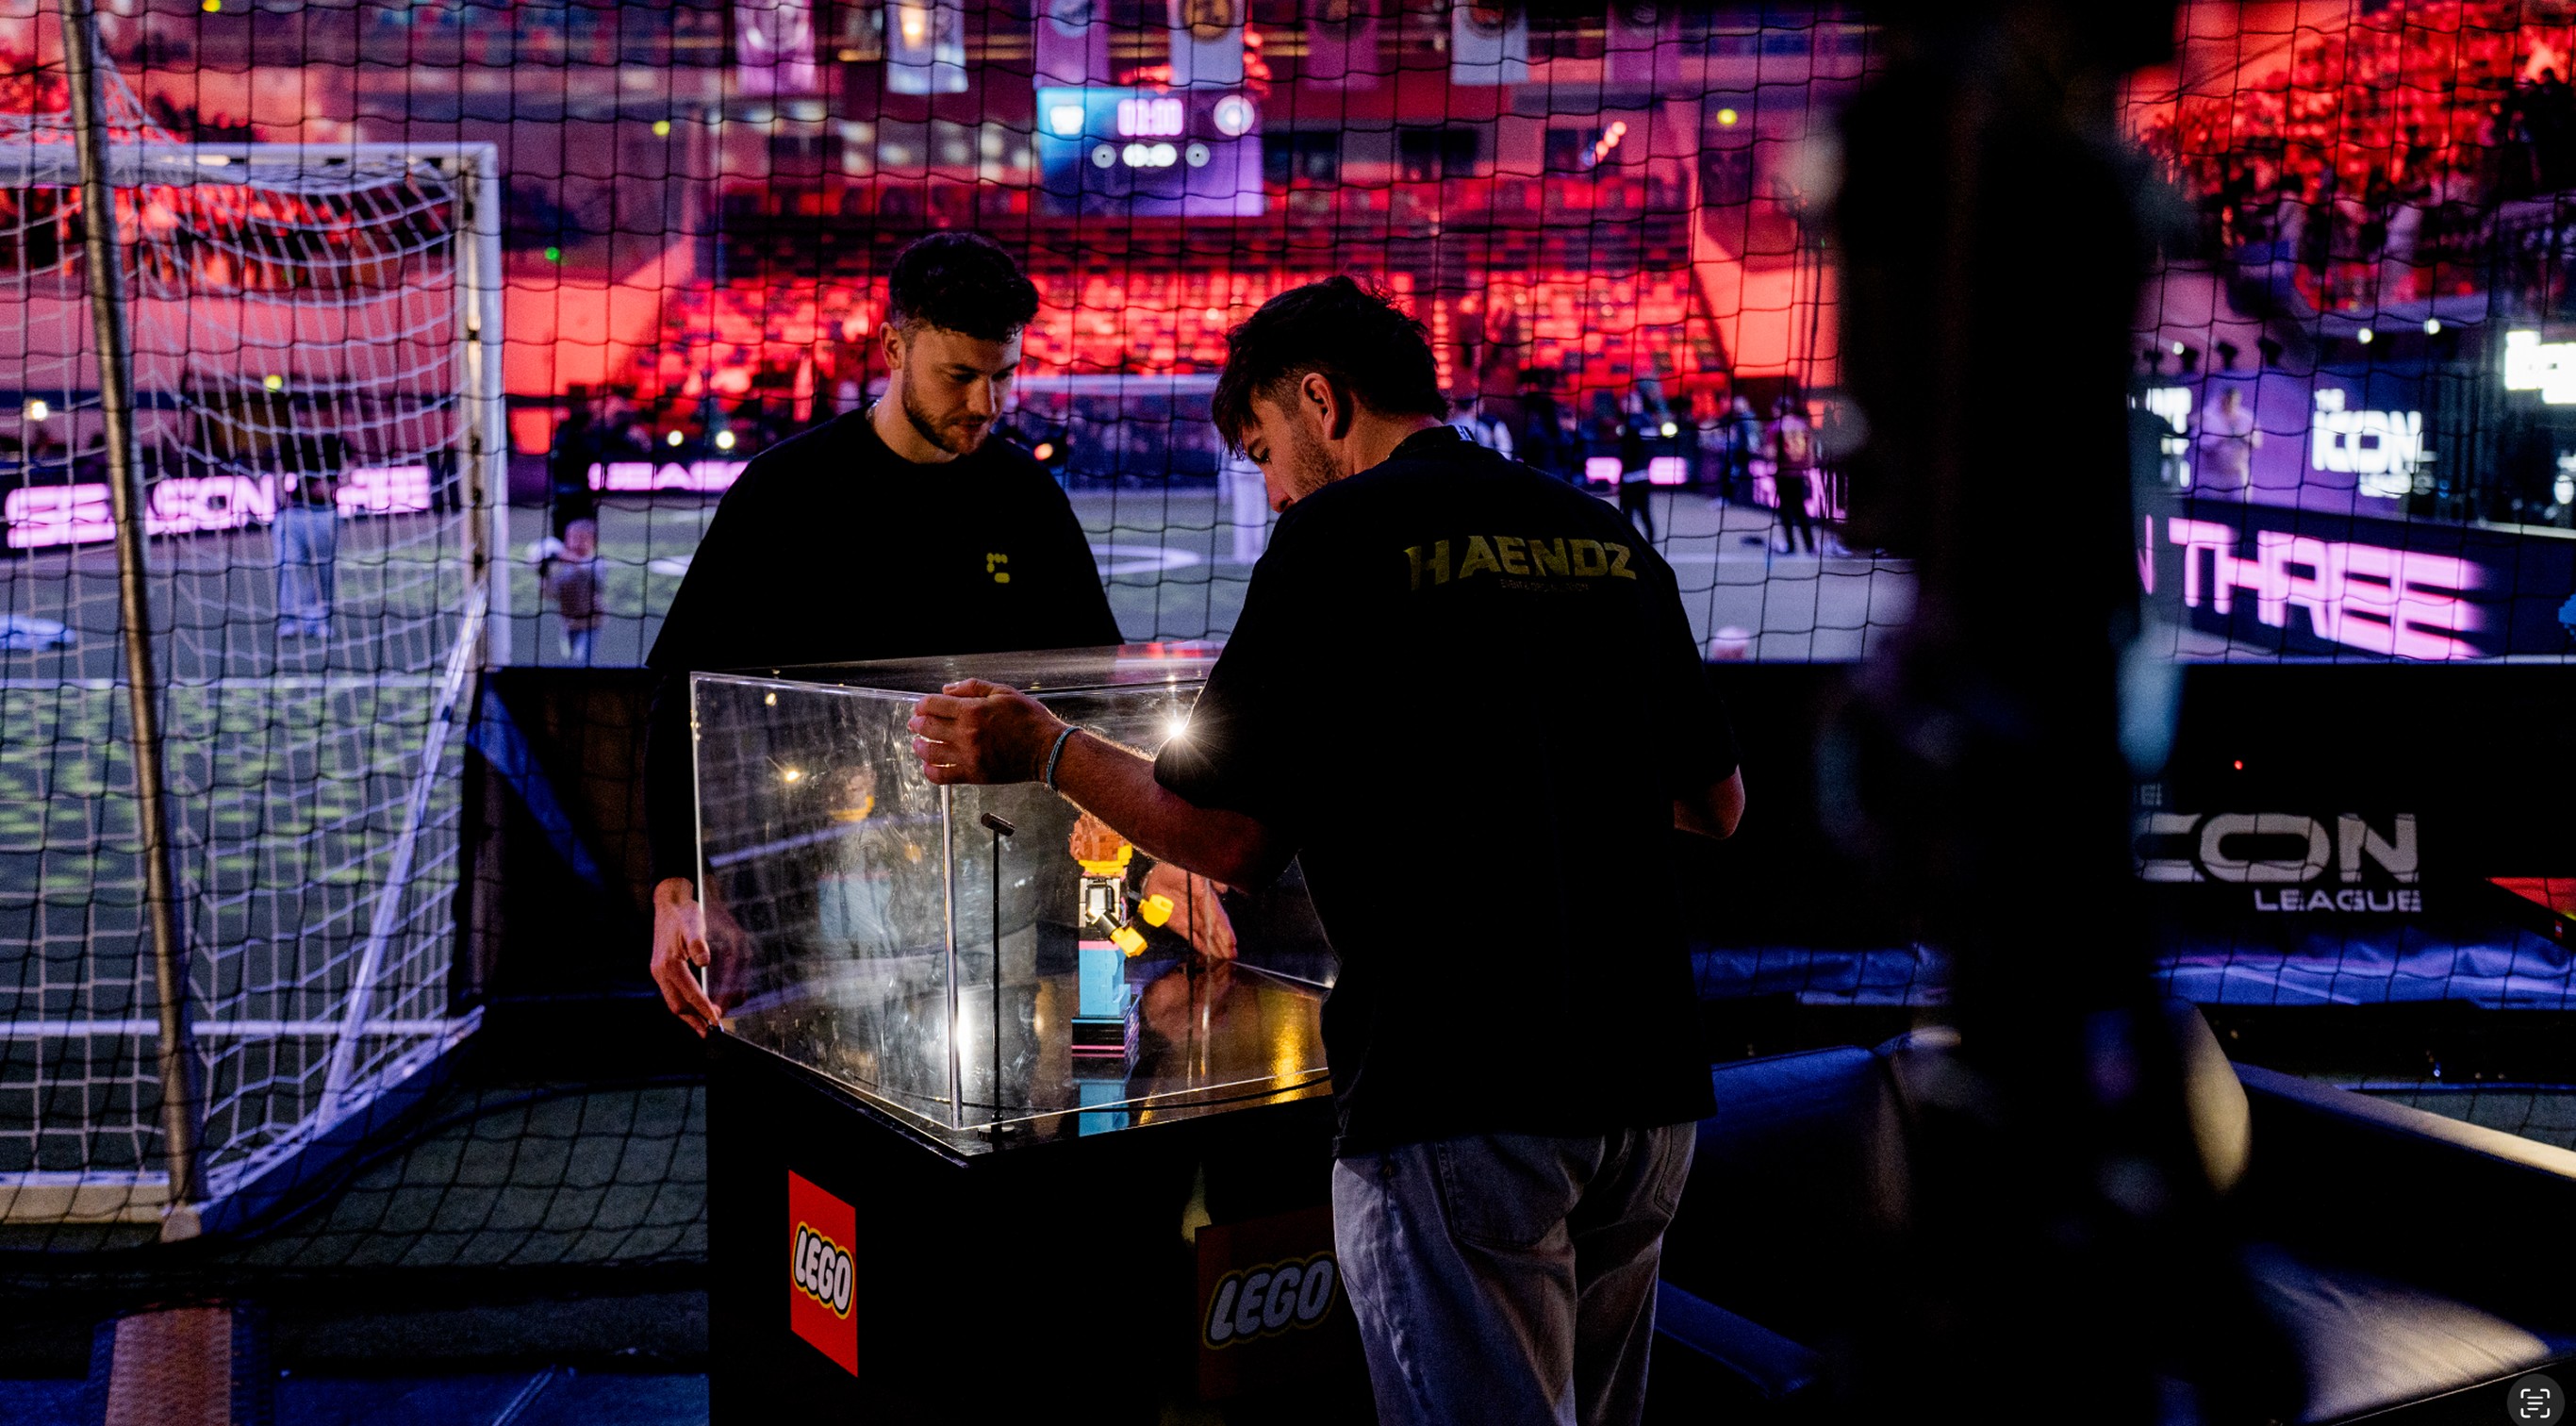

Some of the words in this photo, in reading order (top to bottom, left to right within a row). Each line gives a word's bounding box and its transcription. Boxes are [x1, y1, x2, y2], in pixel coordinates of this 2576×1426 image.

[2311, 409, 2422, 473] ICON
[2168, 515, 2489, 660] THREE
[2133, 812, 2420, 884] CON
[2254, 888, 2422, 912] LEAGUE
[795, 1229, 851, 1311] LEGO
[1210, 1259, 1334, 1341] LEGO
